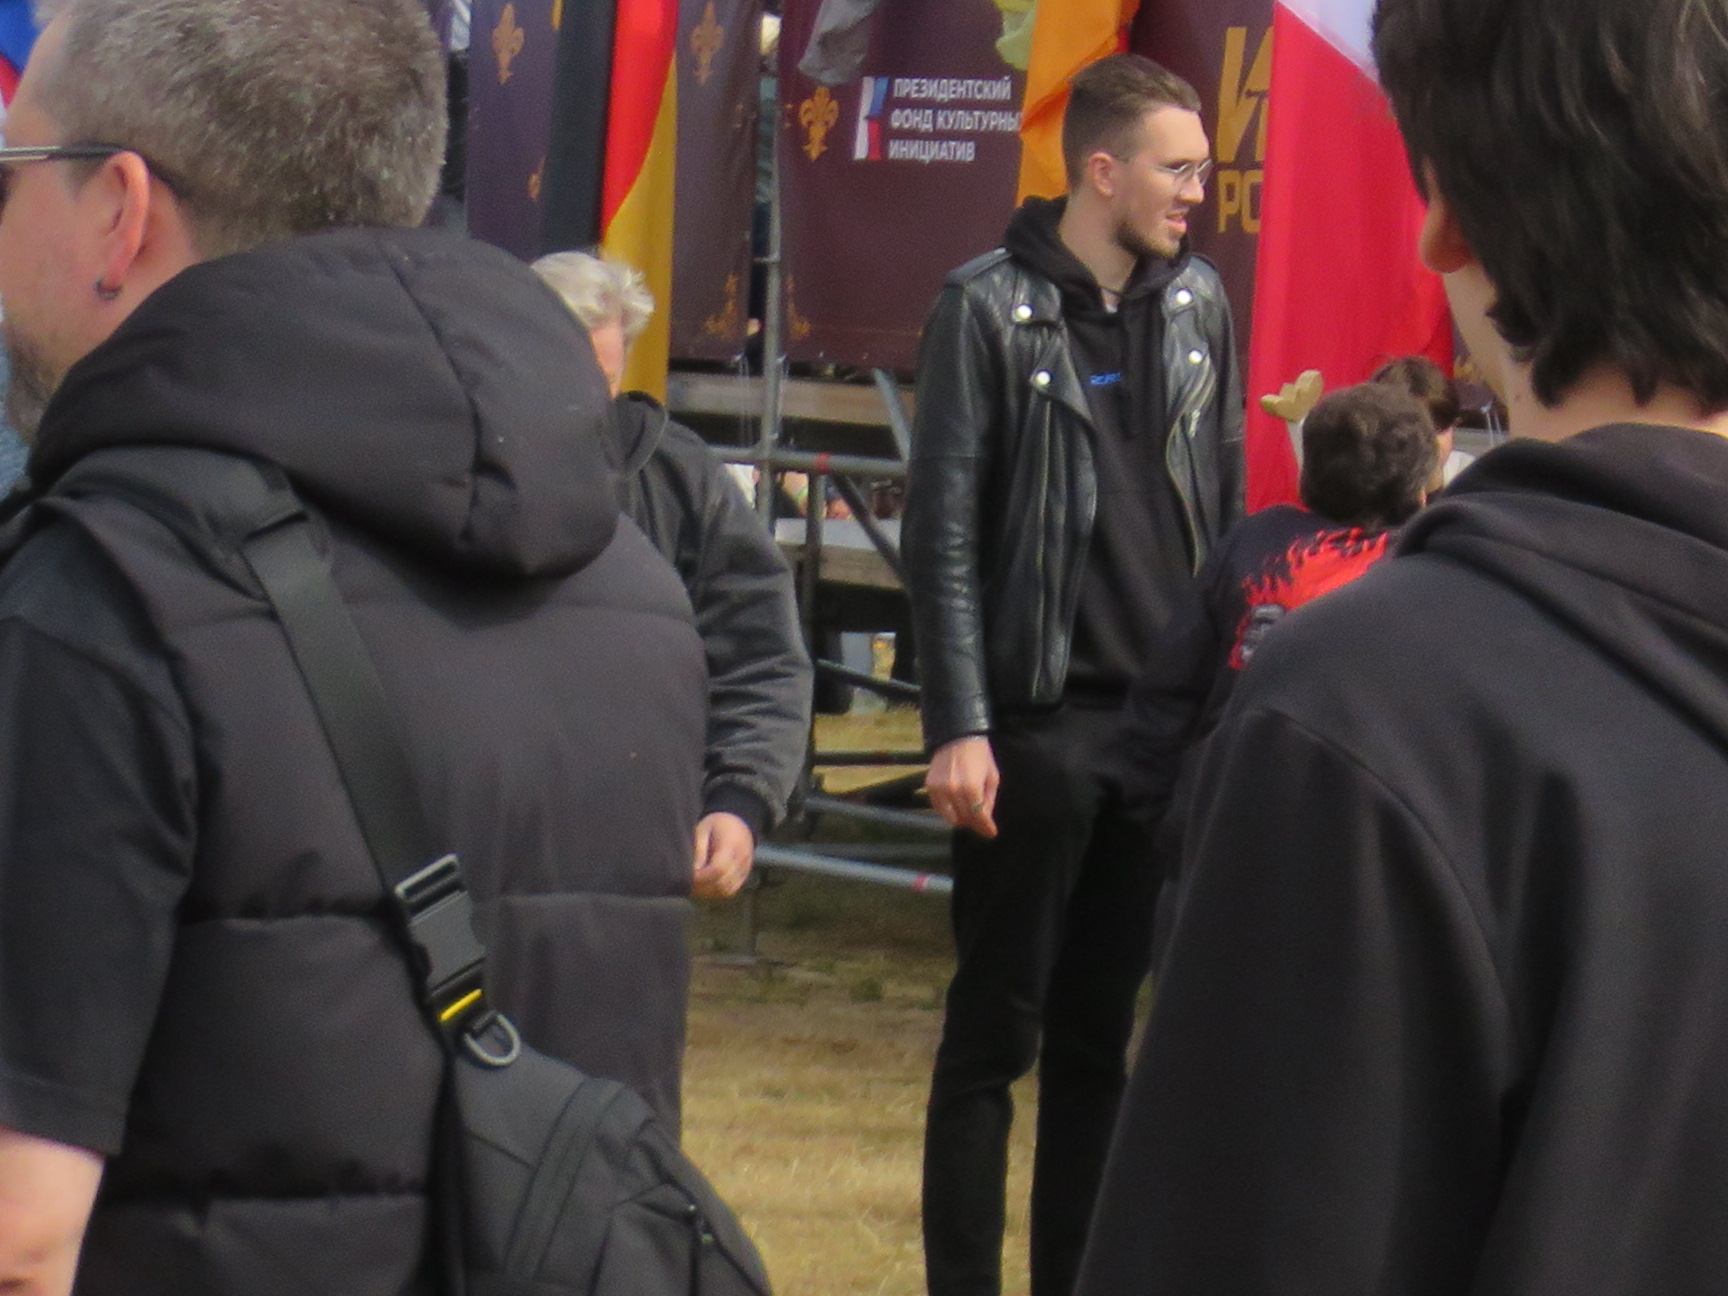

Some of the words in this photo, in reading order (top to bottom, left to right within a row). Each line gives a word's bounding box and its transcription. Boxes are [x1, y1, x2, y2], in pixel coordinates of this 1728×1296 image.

[893, 75, 1011, 102] ПРЕЗИДЕНТСКИЙ
[891, 109, 933, 132] ФОНД
[936, 109, 1021, 131] КУЛЬТУРНЫ
[888, 140, 975, 164] ИНИЦИАТИВ
